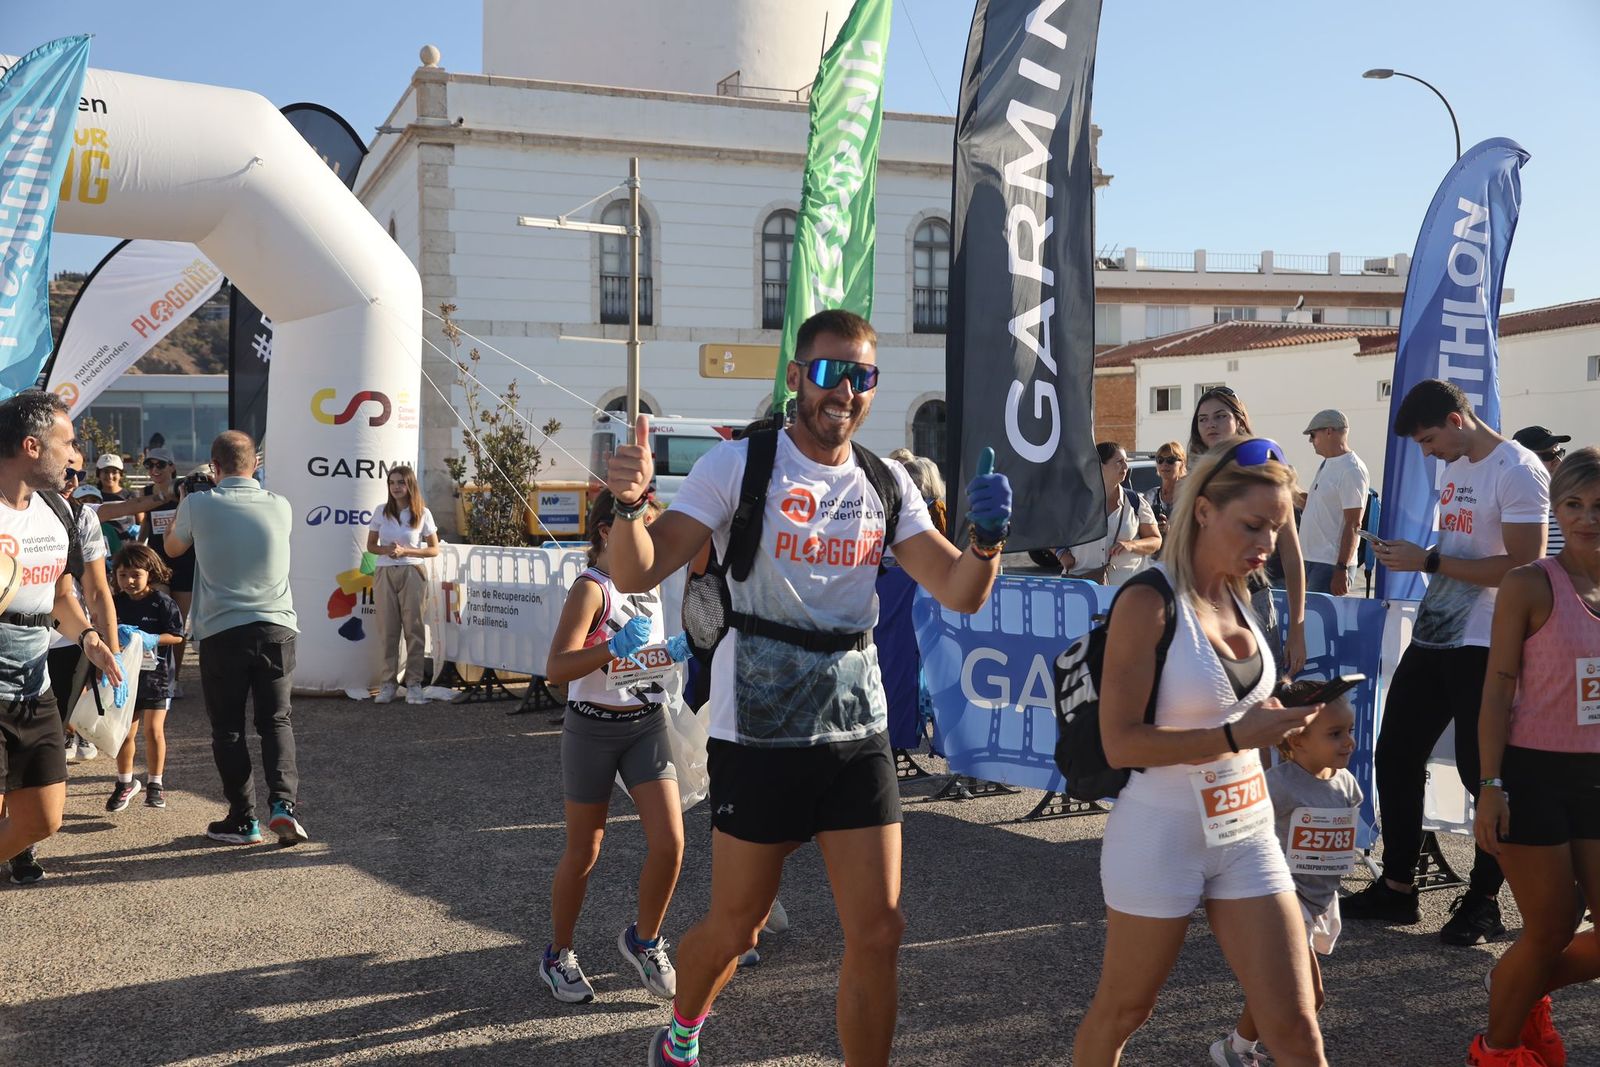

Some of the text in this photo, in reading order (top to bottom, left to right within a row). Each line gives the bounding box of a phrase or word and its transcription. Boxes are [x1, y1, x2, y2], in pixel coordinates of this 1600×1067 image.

[1003, 0, 1068, 464] GARMIN
[130, 263, 218, 339] PLOGGING
[73, 344, 110, 380] nationale
[81, 341, 130, 387] nederlanden
[307, 456, 417, 480] GARM
[334, 509, 372, 526] DEC
[21, 535, 56, 545] nationale
[774, 531, 884, 567] PLOGGING
[466, 601, 519, 616] Transformación
[481, 589, 491, 599] de
[492, 590, 543, 605] Recuperación,
[466, 616, 508, 628] y Resiliencia
[959, 647, 1056, 717] GA
[573, 701, 613, 719] NIKE
[1212, 776, 1263, 812] 25781
[1298, 830, 1351, 849] 25783
